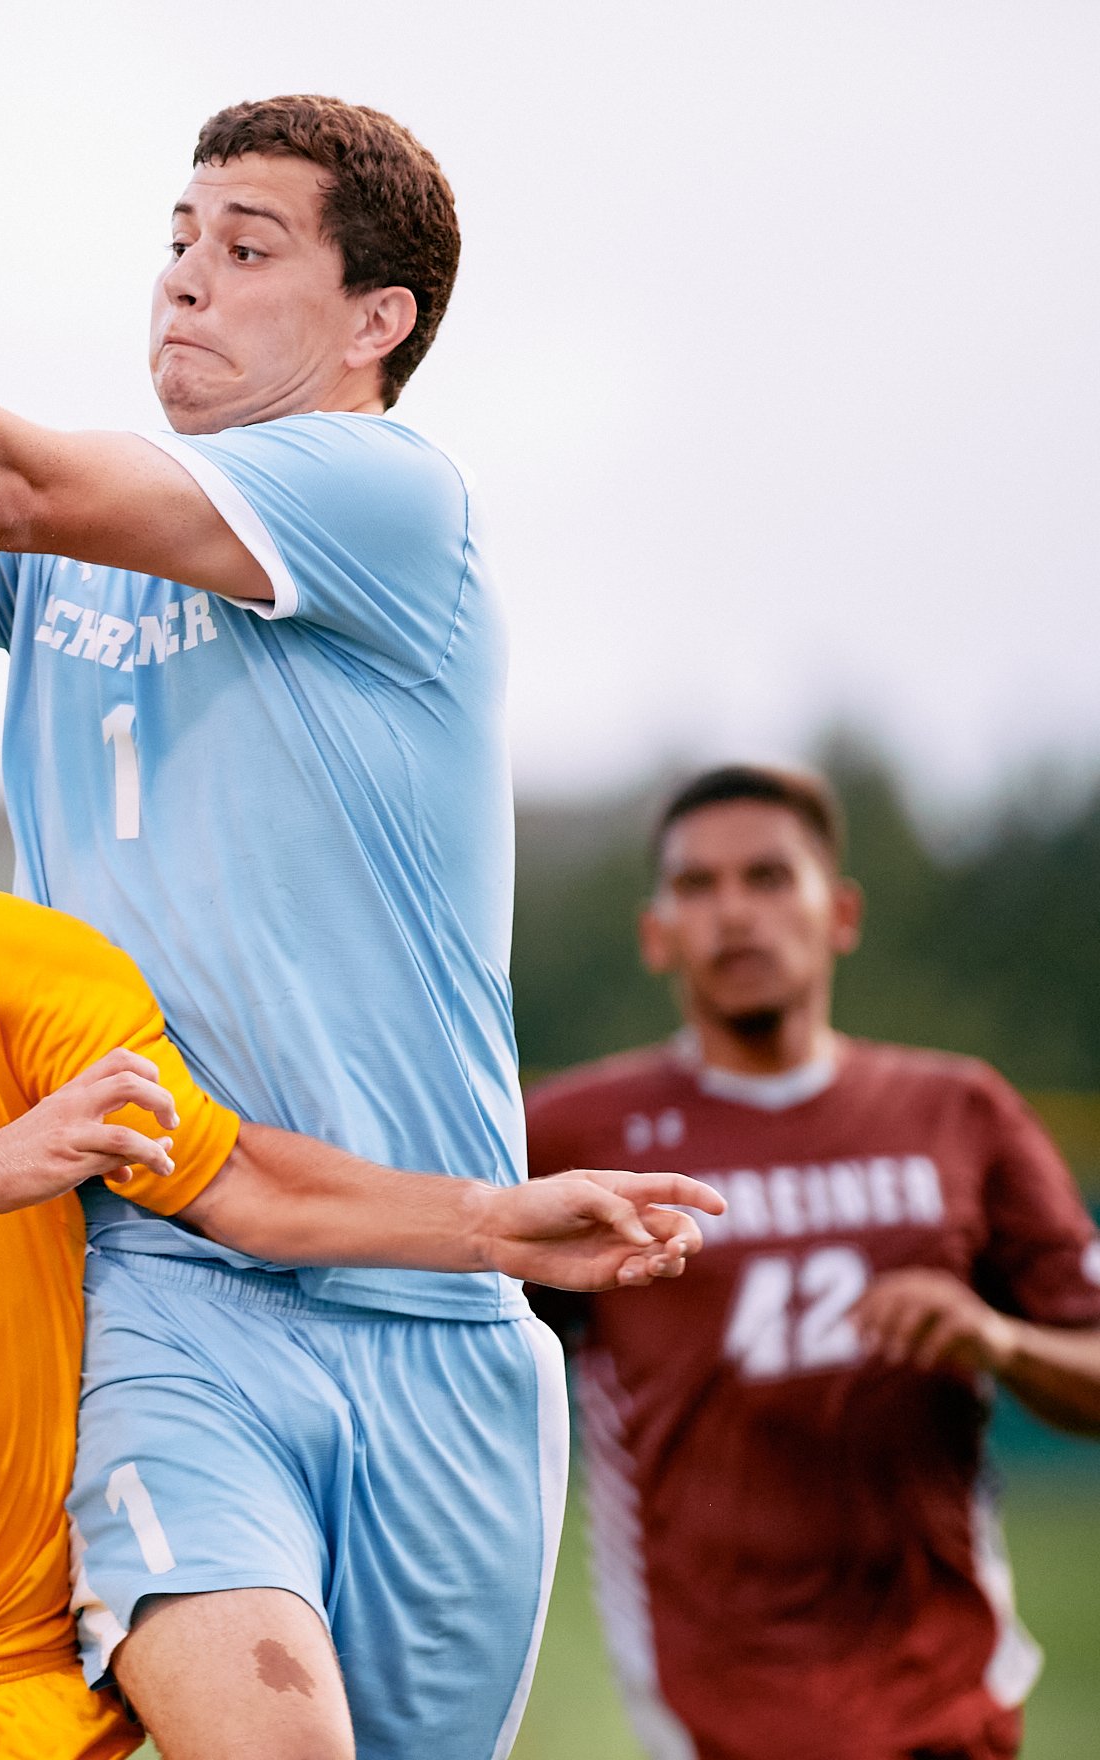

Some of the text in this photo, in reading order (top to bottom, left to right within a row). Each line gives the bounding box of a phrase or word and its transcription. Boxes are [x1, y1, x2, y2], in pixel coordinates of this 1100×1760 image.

[102, 704, 141, 839] 1
[723, 1246, 868, 1381] 42
[104, 1461, 177, 1575] 1
